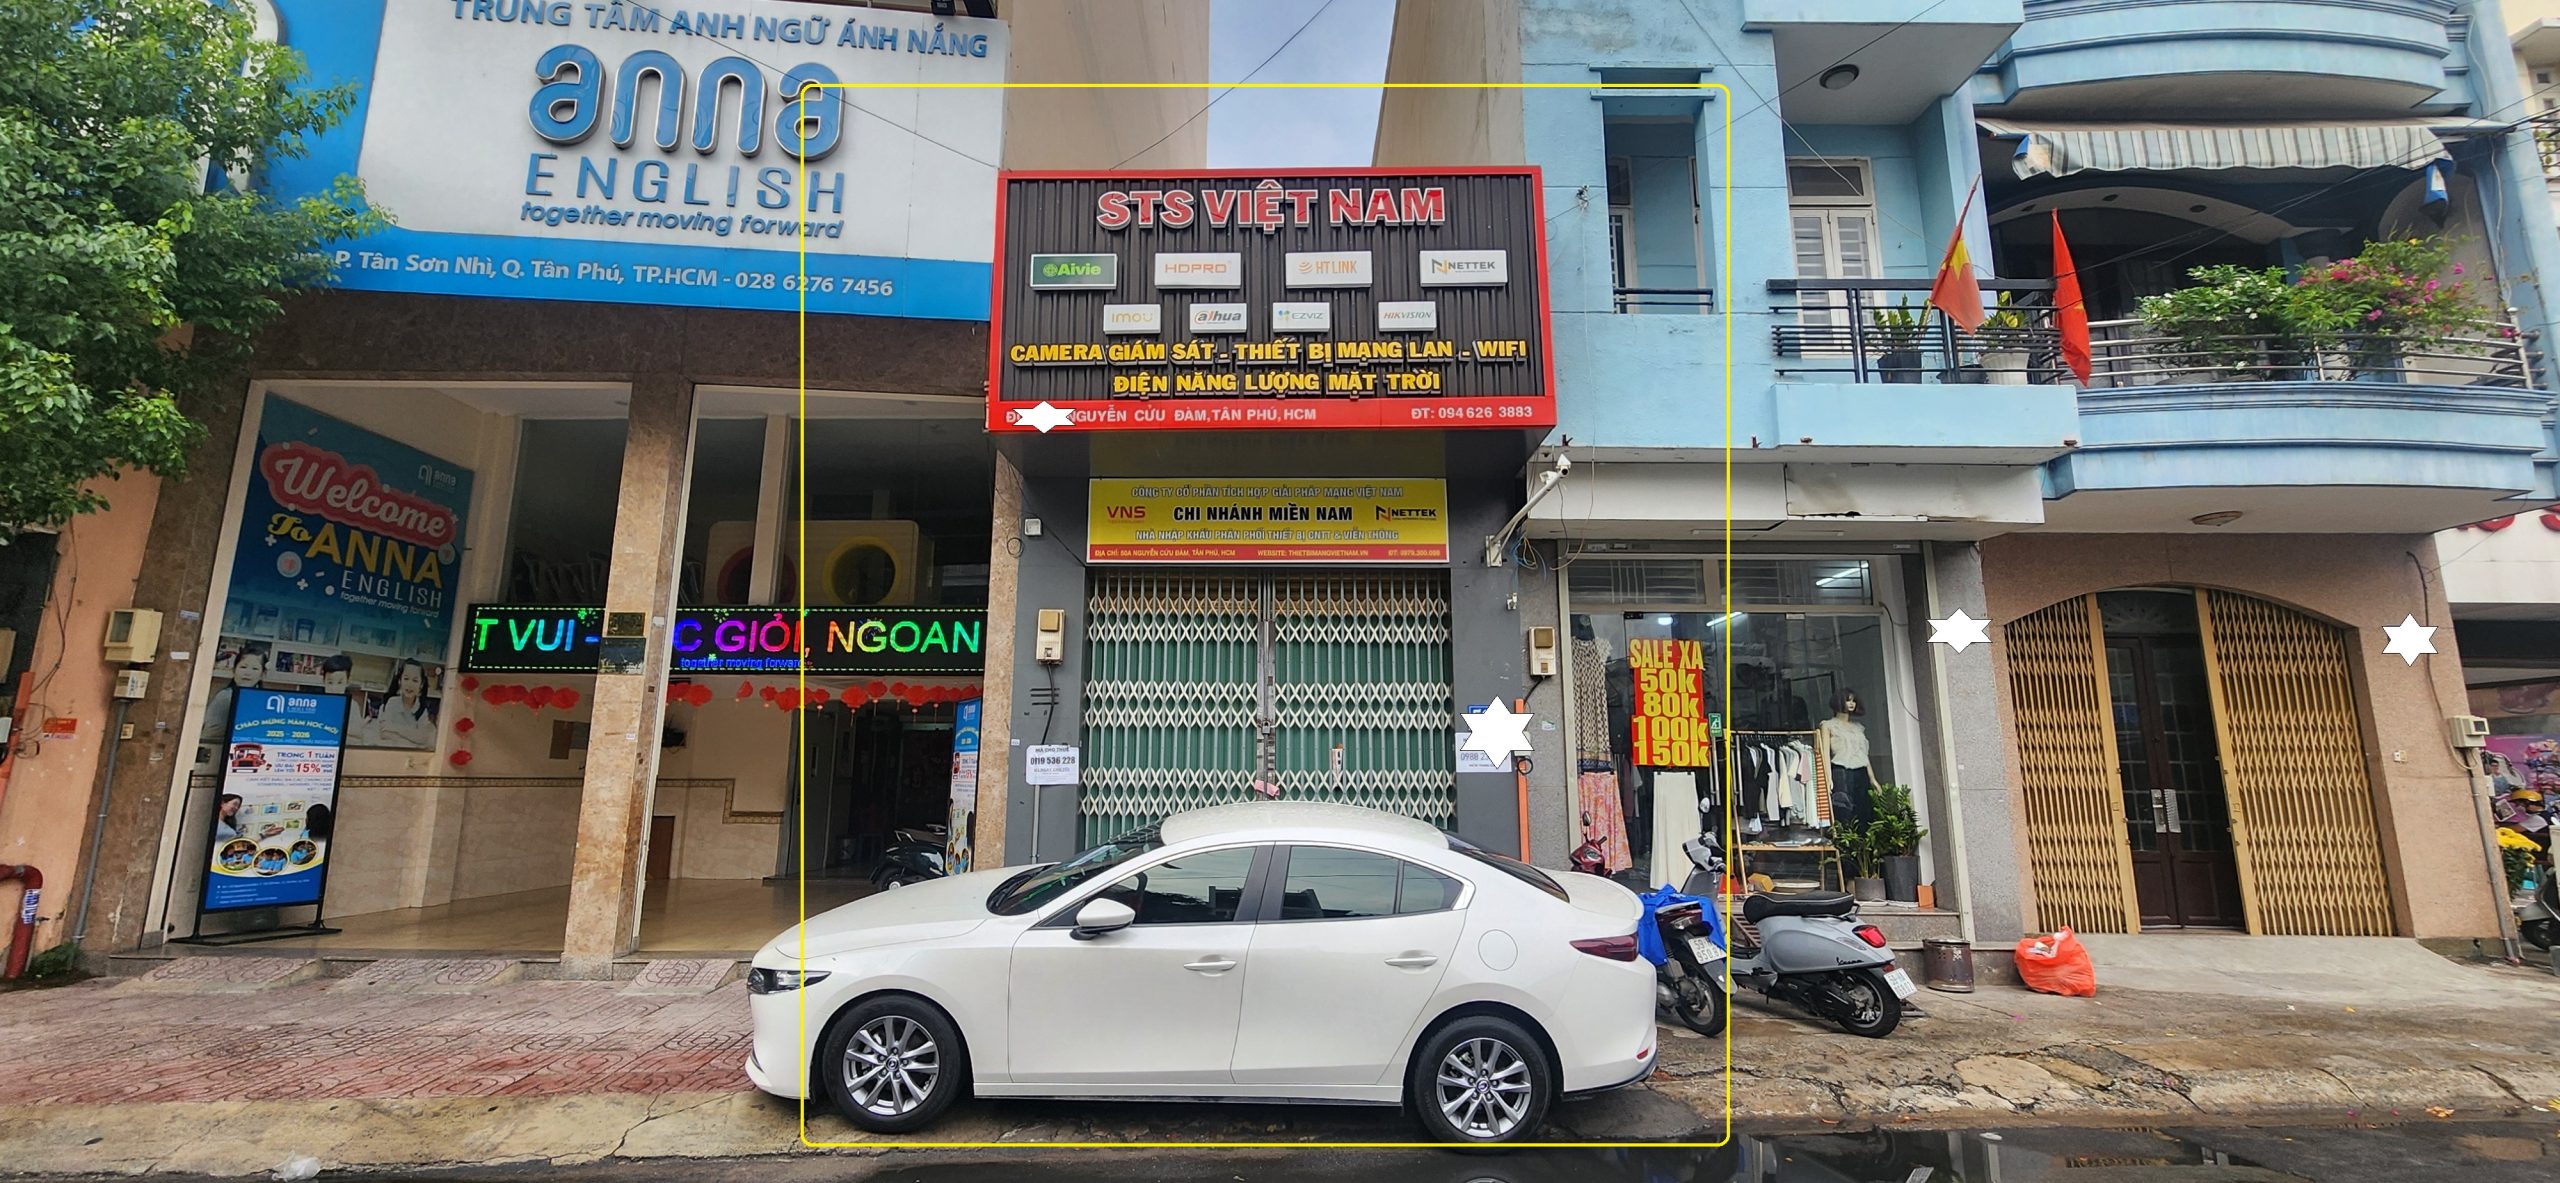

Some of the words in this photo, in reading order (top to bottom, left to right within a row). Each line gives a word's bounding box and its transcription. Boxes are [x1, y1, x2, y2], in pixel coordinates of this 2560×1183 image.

[452, 0, 573, 27] TRUNG
[584, 1, 660, 33] TÂM
[668, 9, 746, 40] ANH
[752, 14, 831, 46] NGỮ
[836, 17, 899, 51] ÁNH
[906, 22, 989, 58] NẮNG
[527, 43, 846, 161] anna
[525, 152, 846, 214] ENGLISH
[1096, 189, 1197, 231] STS
[1201, 178, 1319, 235] VIỆT
[1328, 187, 1446, 228] NAM
[519, 201, 635, 227] together
[636, 211, 733, 237] moving
[739, 214, 845, 239] forward
[335, 250, 352, 268] P.
[358, 250, 399, 271] Tân
[404, 253, 449, 274] Sơn
[454, 256, 497, 279] Nhì,
[501, 259, 525, 278] Q.
[531, 260, 570, 280] Tân
[576, 263, 625, 286] Phú,
[633, 265, 717, 288] TP.HCM
[735, 271, 776, 290] 028
[782, 274, 834, 293] 6276
[841, 277, 894, 297] 7456
[1057, 262, 1102, 276] Aivie
[1164, 263, 1228, 274] HDPRO
[1447, 261, 1496, 270] NETTEK
[1291, 312, 1325, 320] EZVIZ
[1383, 311, 1432, 319] HIKVISION
[1010, 343, 1104, 362] CAMERA
[1107, 339, 1166, 362] GIÁM
[1171, 338, 1215, 361] SÁT
[1234, 338, 1300, 361] THIẾT
[1308, 342, 1332, 363] BỊ
[1337, 341, 1403, 362] MẠNG
[1409, 341, 1454, 358] LAN
[1476, 340, 1528, 358] WIFI
[1112, 372, 1169, 395] ĐIỆN
[1175, 371, 1238, 392] NĂNG
[1244, 370, 1320, 394] LƯỢNG
[1328, 371, 1377, 394] MẶT
[1386, 369, 1441, 391] TRỜI
[1134, 404, 1166, 422] CỬU
[1411, 407, 1436, 420] ĐT:
[1438, 408, 1464, 420] 094
[1466, 407, 1493, 420] 626
[1498, 406, 1533, 419] 3883
[274, 456, 447, 538] Welcome
[1131, 486, 1159, 497] CÔNG
[1162, 487, 1173, 497] TY
[1222, 485, 1244, 497] TÍCH
[1294, 485, 1321, 497] PHÁP
[1324, 487, 1353, 499] MẠNG
[1355, 486, 1377, 499] VIỆT
[1380, 487, 1404, 497] NAM
[1107, 506, 1146, 519] VNS
[1173, 506, 1201, 521] CHI
[1206, 503, 1263, 521] NHÁNH
[1269, 502, 1310, 521] MIỀN
[1316, 506, 1353, 521] NAM
[1391, 508, 1437, 517] NETTEK
[1333, 530, 1343, 540] &
[267, 512, 313, 542] To
[304, 522, 443, 590] ANNA
[340, 569, 442, 609] ENGLISH
[340, 590, 378, 606] together
[377, 597, 410, 614] moving
[508, 618, 576, 651] VUI
[826, 620, 980, 654] NGOAN
[1629, 638, 1674, 669] SALE
[1640, 668, 1697, 694] 50k
[288, 697, 317, 708] anna
[1643, 692, 1701, 718] 80k
[1632, 715, 1709, 743] 100k
[277, 751, 305, 759] TRONG
[1633, 740, 1711, 767] 150k
[296, 763, 321, 774] 15%
